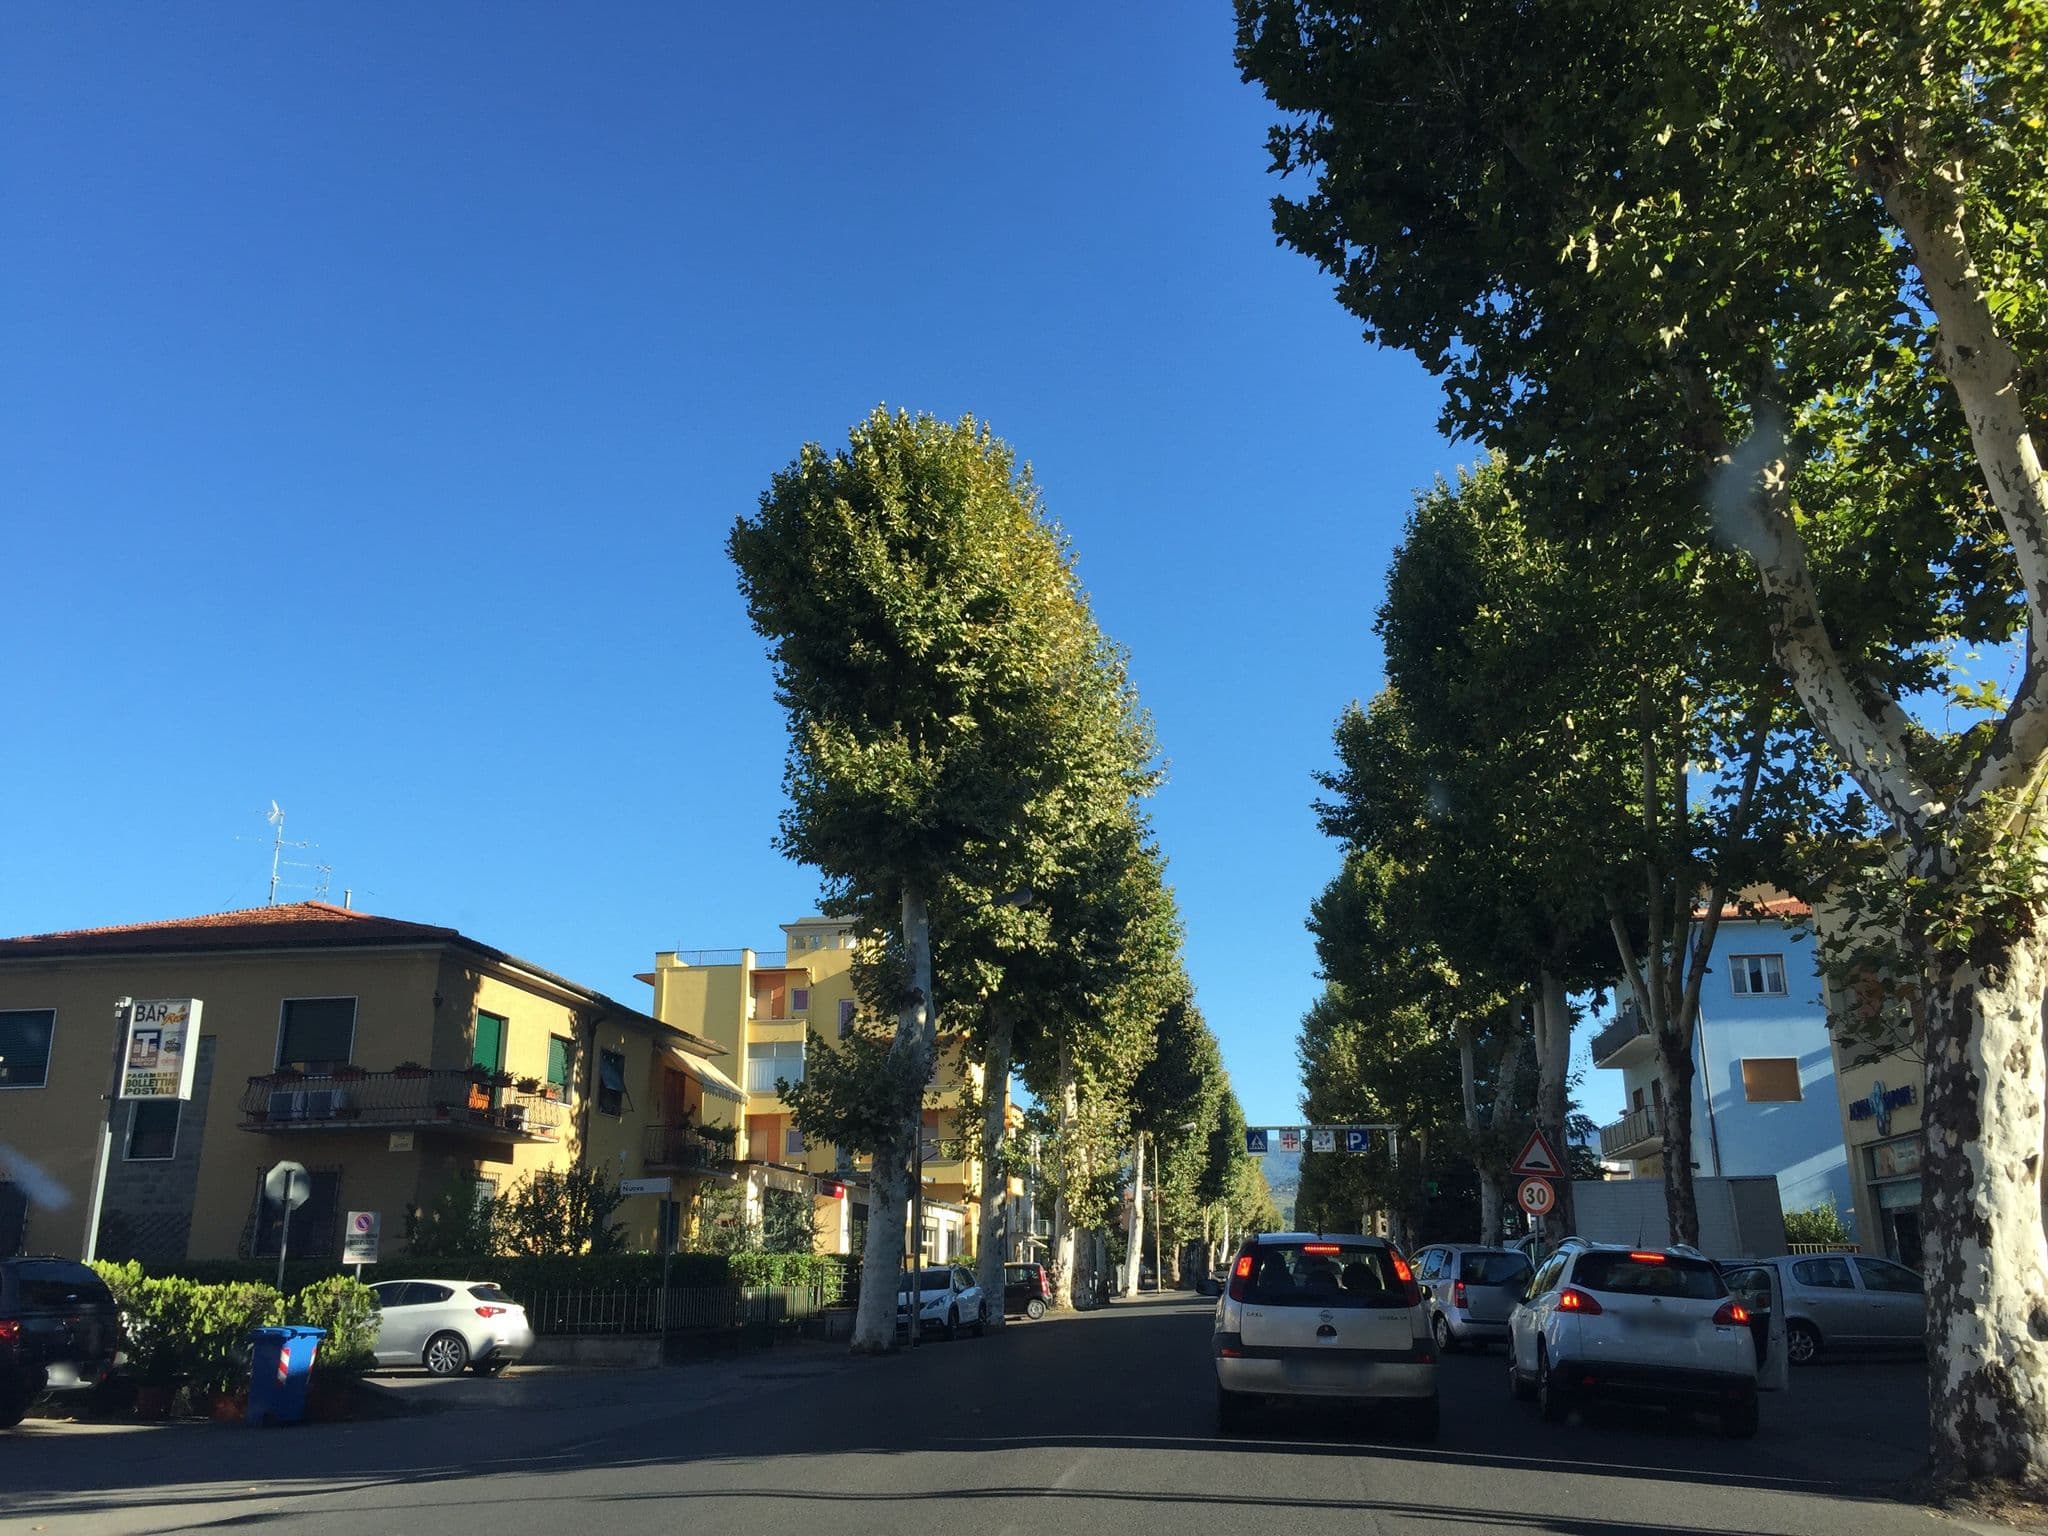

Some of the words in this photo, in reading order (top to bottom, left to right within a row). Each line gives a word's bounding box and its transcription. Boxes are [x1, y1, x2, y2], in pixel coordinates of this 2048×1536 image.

[135, 1005, 167, 1022] BAR
[124, 1087, 177, 1096] POSTALI
[126, 1078, 178, 1088] BOLLETTINI
[1349, 1132, 1361, 1149] P
[1526, 1187, 1547, 1205] 30
